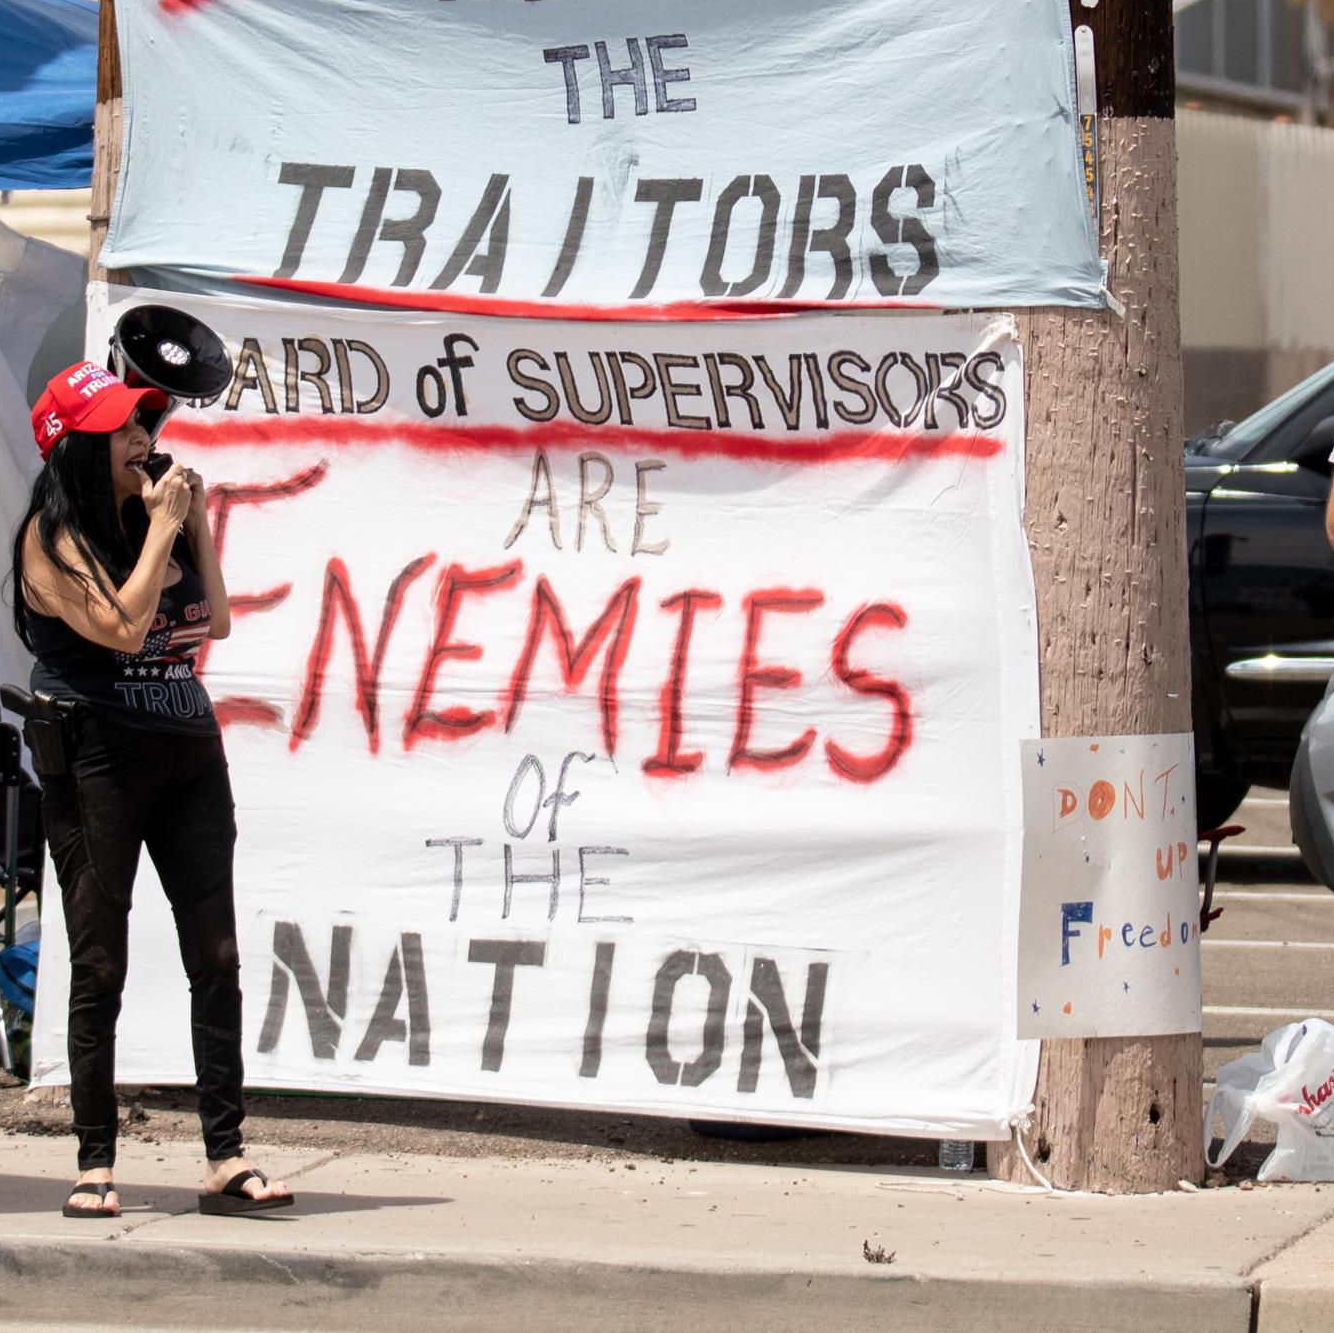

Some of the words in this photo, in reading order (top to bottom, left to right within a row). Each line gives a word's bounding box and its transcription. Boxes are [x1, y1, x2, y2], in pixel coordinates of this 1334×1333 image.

[543, 33, 697, 124] THE
[274, 162, 937, 302] TRAITORS
[45, 412, 63, 438] 45
[197, 337, 390, 414] ARD
[416, 333, 480, 418] of
[505, 348, 1007, 431] SUPERVISORS
[504, 446, 671, 557] ARE
[197, 459, 916, 784] ENEMIES
[114, 680, 214, 719] TRUM
[165, 664, 192, 680] AND
[1051, 763, 1180, 834] DONT
[425, 836, 634, 924] THE
[1156, 841, 1188, 880] UP
[257, 921, 829, 1098] NATION
